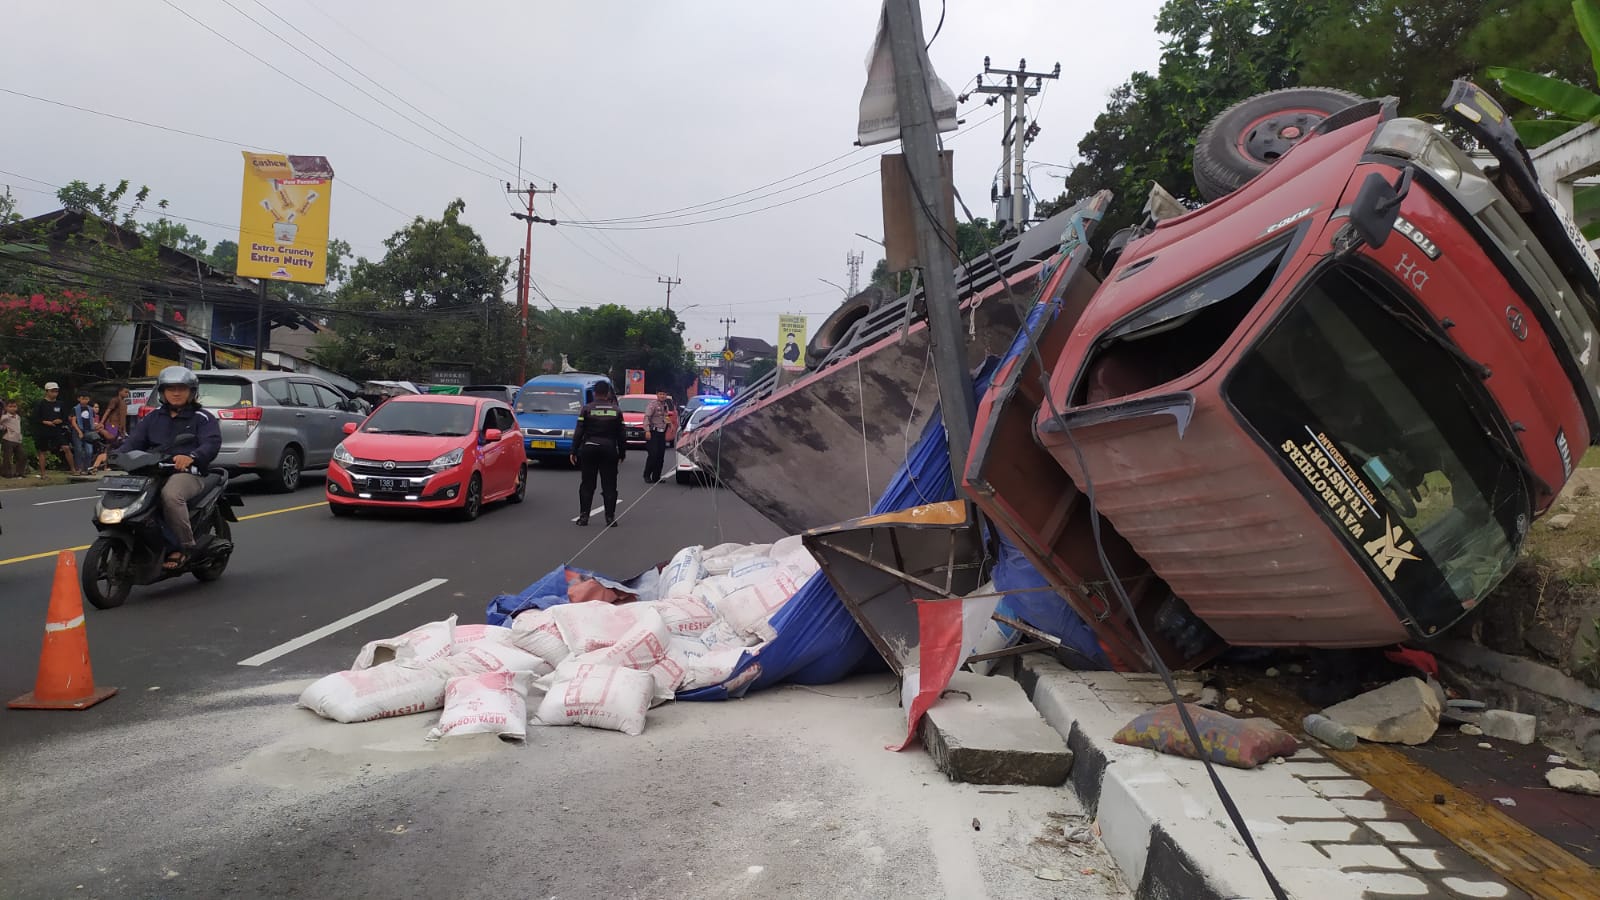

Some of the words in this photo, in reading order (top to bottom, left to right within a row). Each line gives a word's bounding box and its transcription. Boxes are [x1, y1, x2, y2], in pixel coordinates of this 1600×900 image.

[252, 159, 287, 168] Cashew
[250, 252, 280, 263] Extra
[283, 256, 313, 269] Nutty
[252, 243, 275, 252] Extra
[278, 246, 314, 258] Crunchy
[1395, 253, 1429, 291] DH
[1317, 432, 1347, 467] SERDANG
[1556, 430, 1573, 480] DYNA
[1281, 439, 1339, 508] BROTHERS
[1302, 440, 1368, 518] TRANSPORT
[1344, 465, 1360, 483] DELI
[1357, 480, 1377, 506] PUTRA
[1335, 504, 1365, 539] WAN
